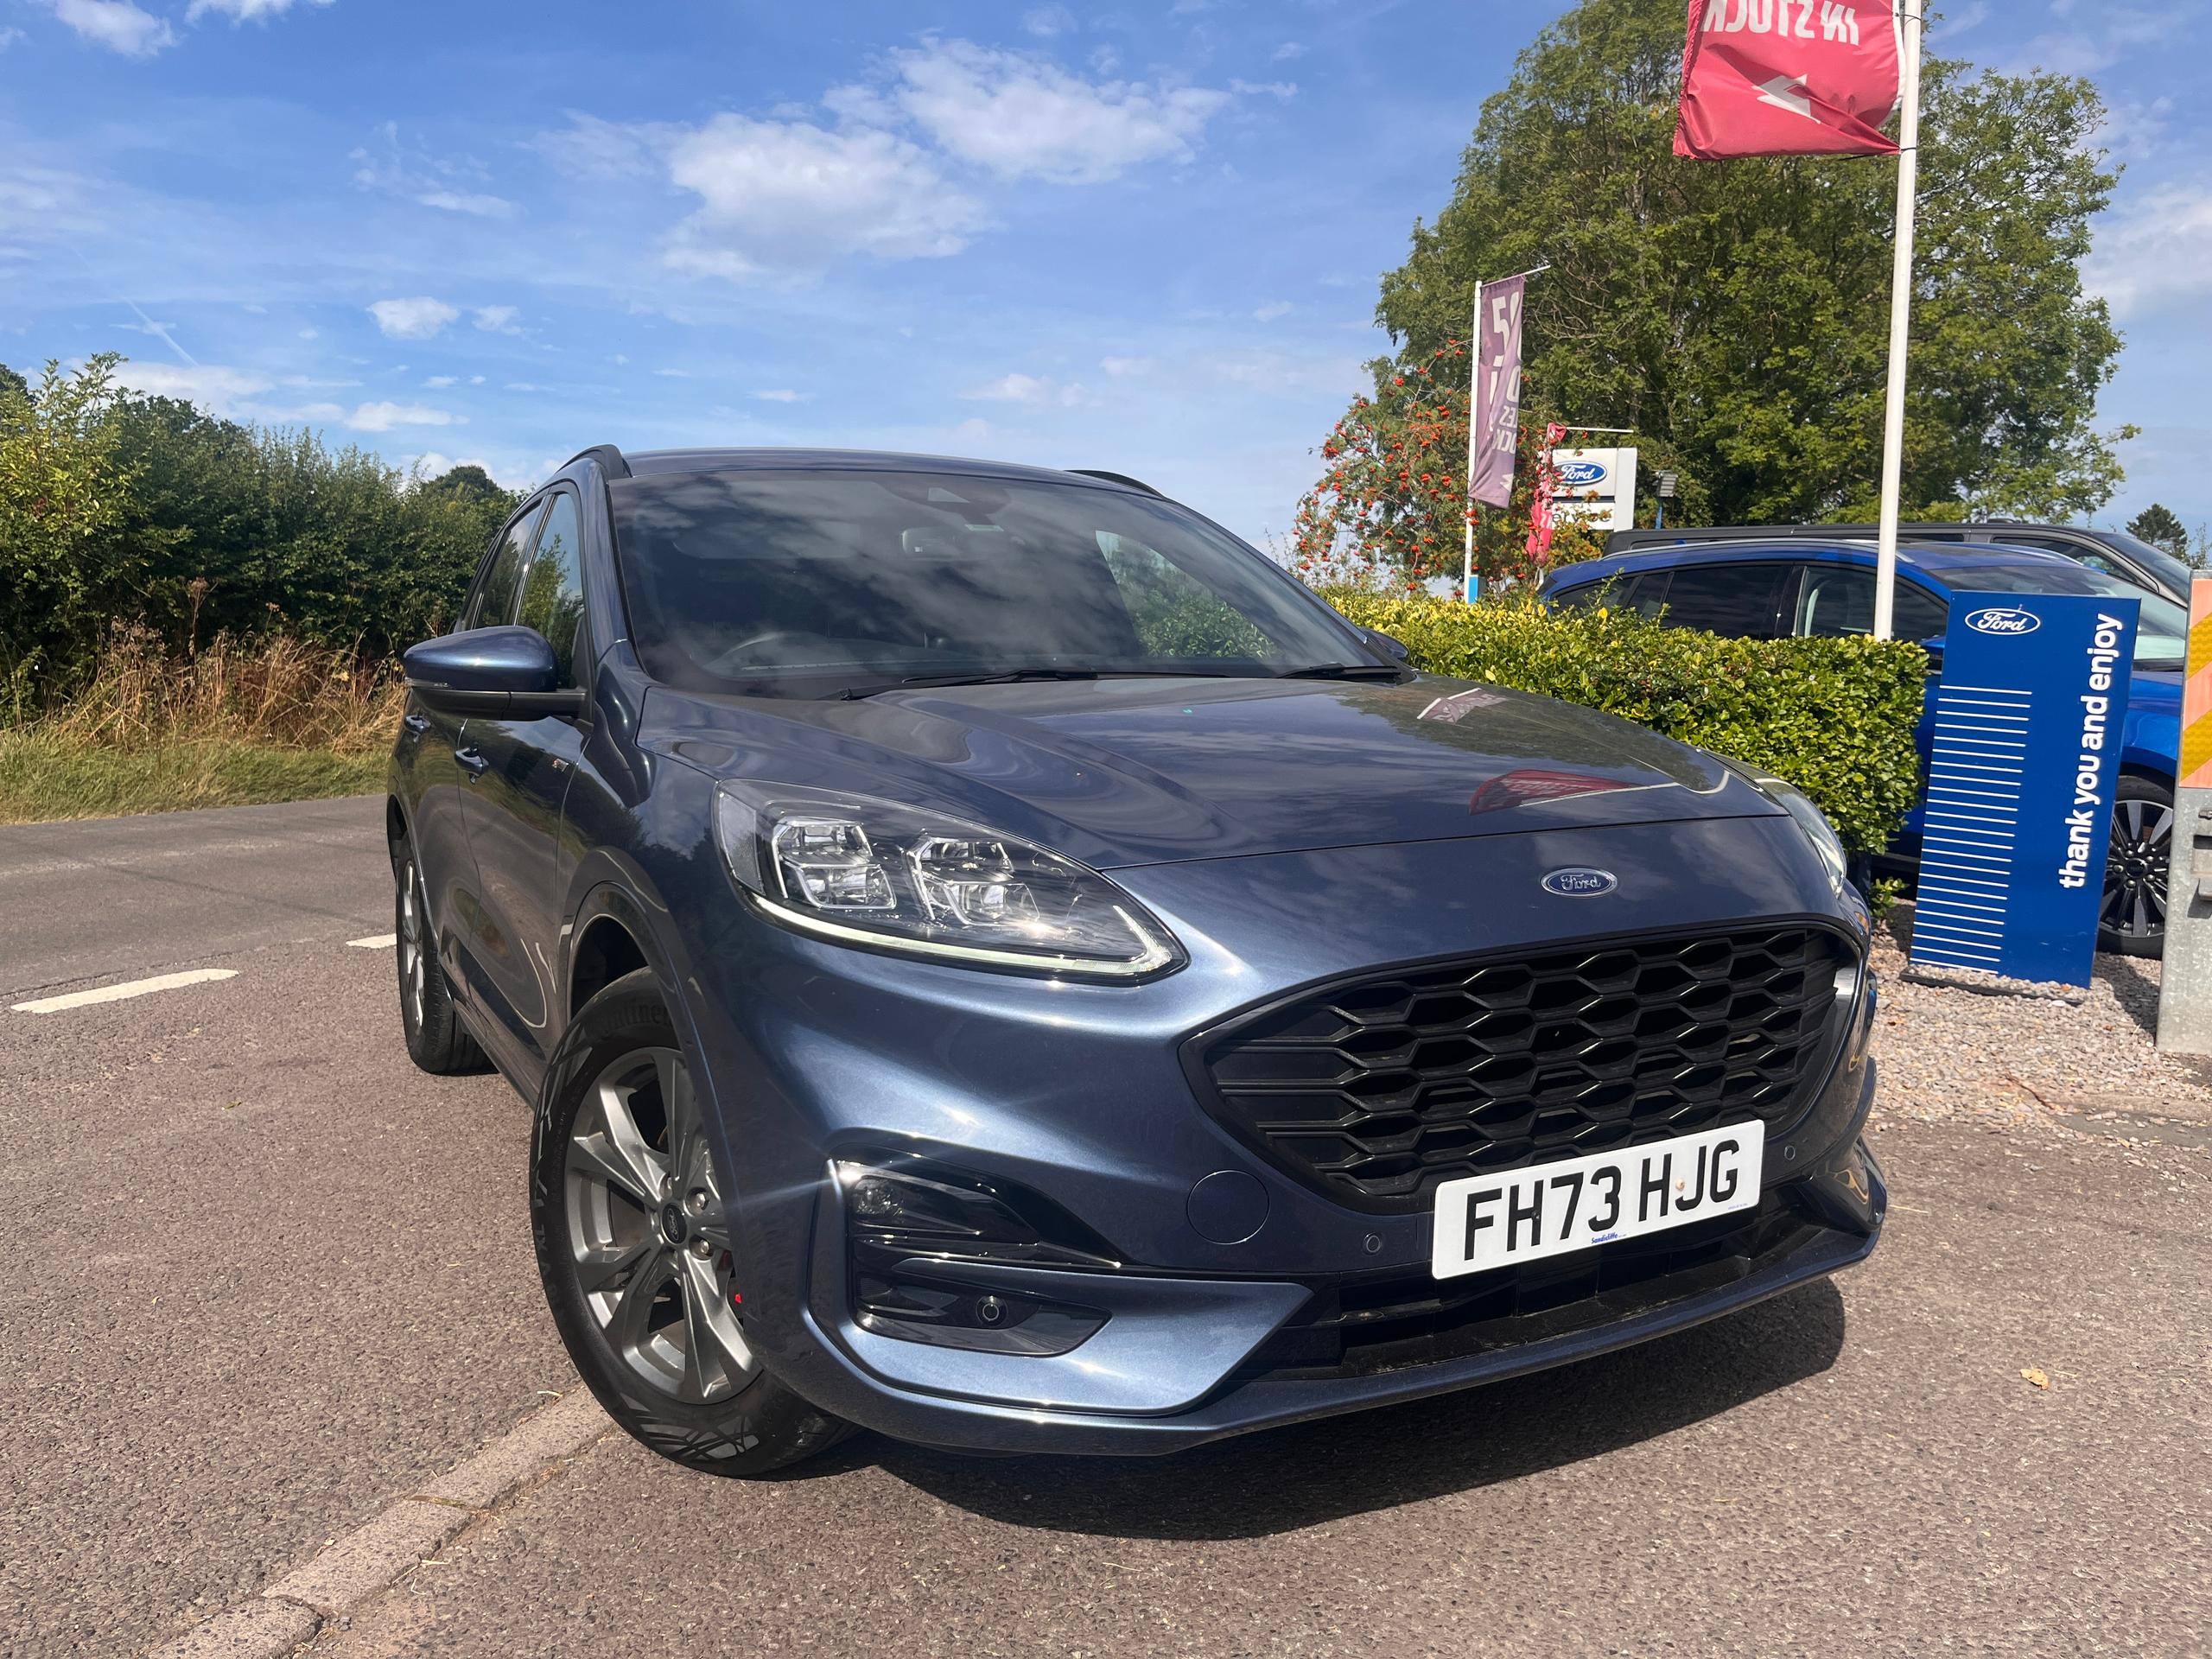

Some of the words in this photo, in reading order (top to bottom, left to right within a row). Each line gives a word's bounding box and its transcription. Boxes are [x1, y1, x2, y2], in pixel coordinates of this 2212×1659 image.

[1560, 463, 1595, 480] Ford
[1977, 612, 2028, 631] Ford
[2087, 613, 2123, 690] enjoy
[2081, 690, 2107, 751] and
[2075, 755, 2101, 806] you
[2059, 810, 2093, 889] thank
[1560, 874, 1601, 891] Ford
[1464, 1165, 1623, 1262] FH73
[1638, 1139, 1740, 1223] HJG
